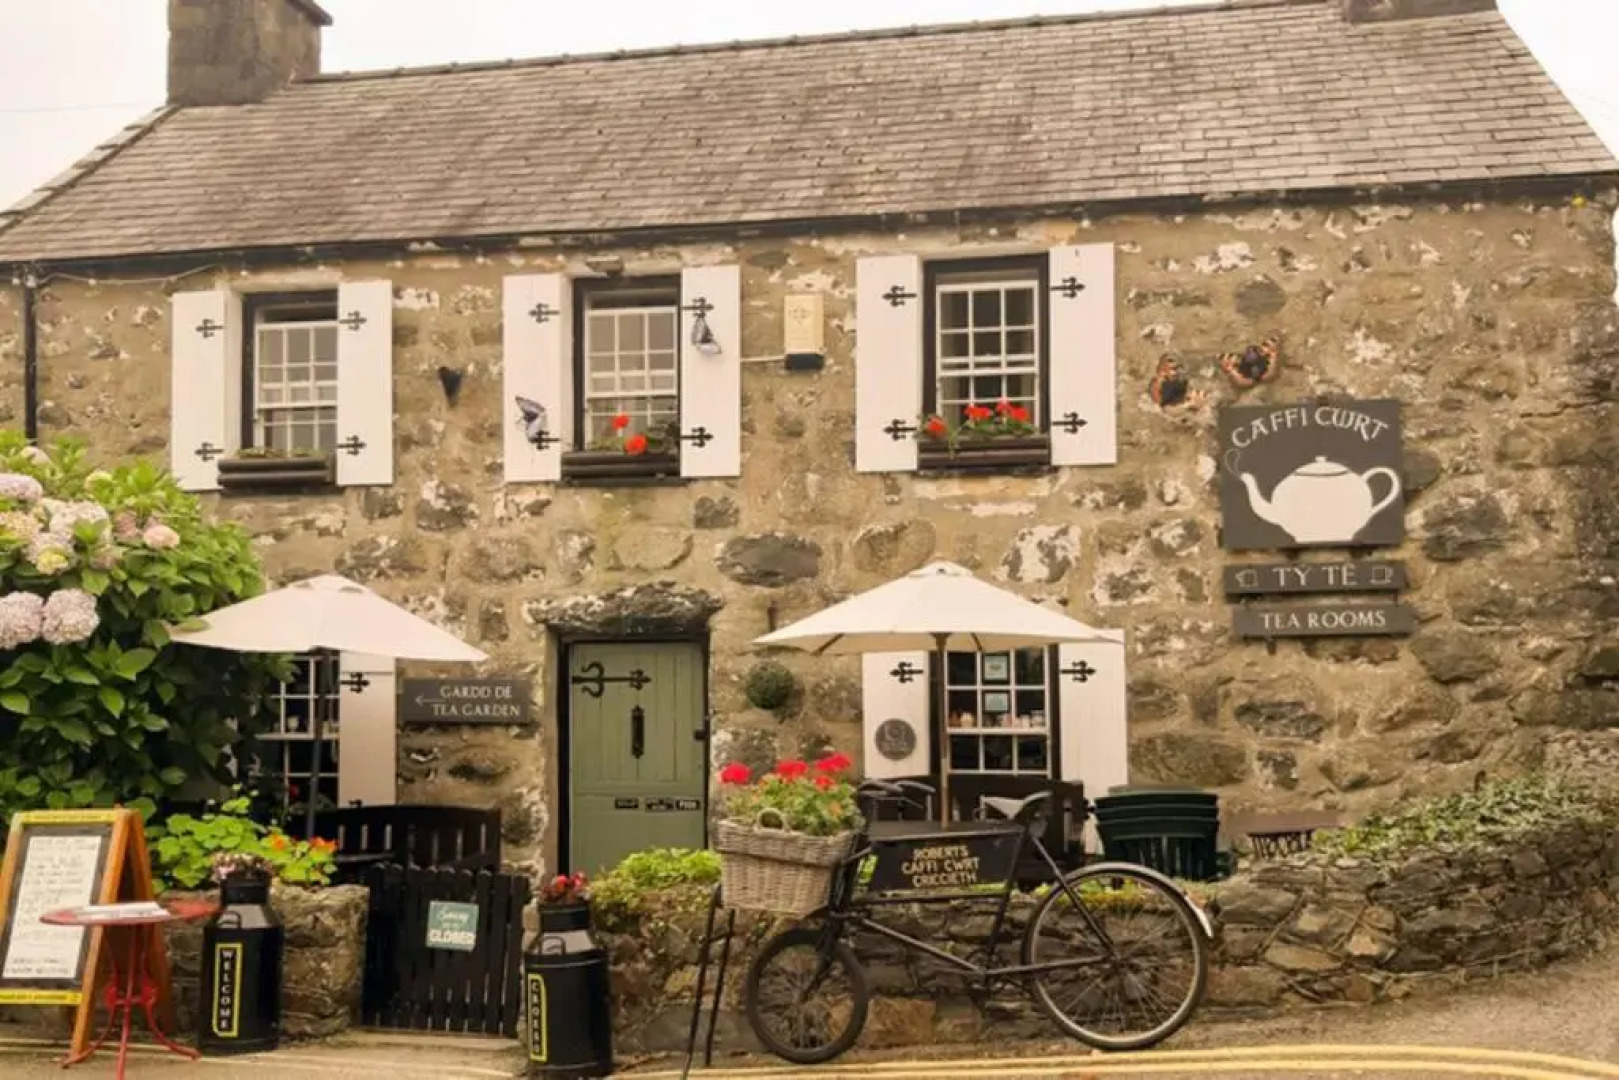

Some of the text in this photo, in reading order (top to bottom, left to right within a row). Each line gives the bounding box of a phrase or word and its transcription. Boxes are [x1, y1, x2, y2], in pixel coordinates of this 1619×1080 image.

[1232, 406, 1389, 448] CAFFI CWRT
[1260, 611, 1386, 630] TEA ROOMS
[432, 703, 521, 717] TEA GARDEN
[913, 845, 969, 861] ROBERTS
[901, 856, 980, 875] CAFFI CWRT
[429, 929, 475, 945] CLOSED
[219, 949, 235, 1029] WELCOME
